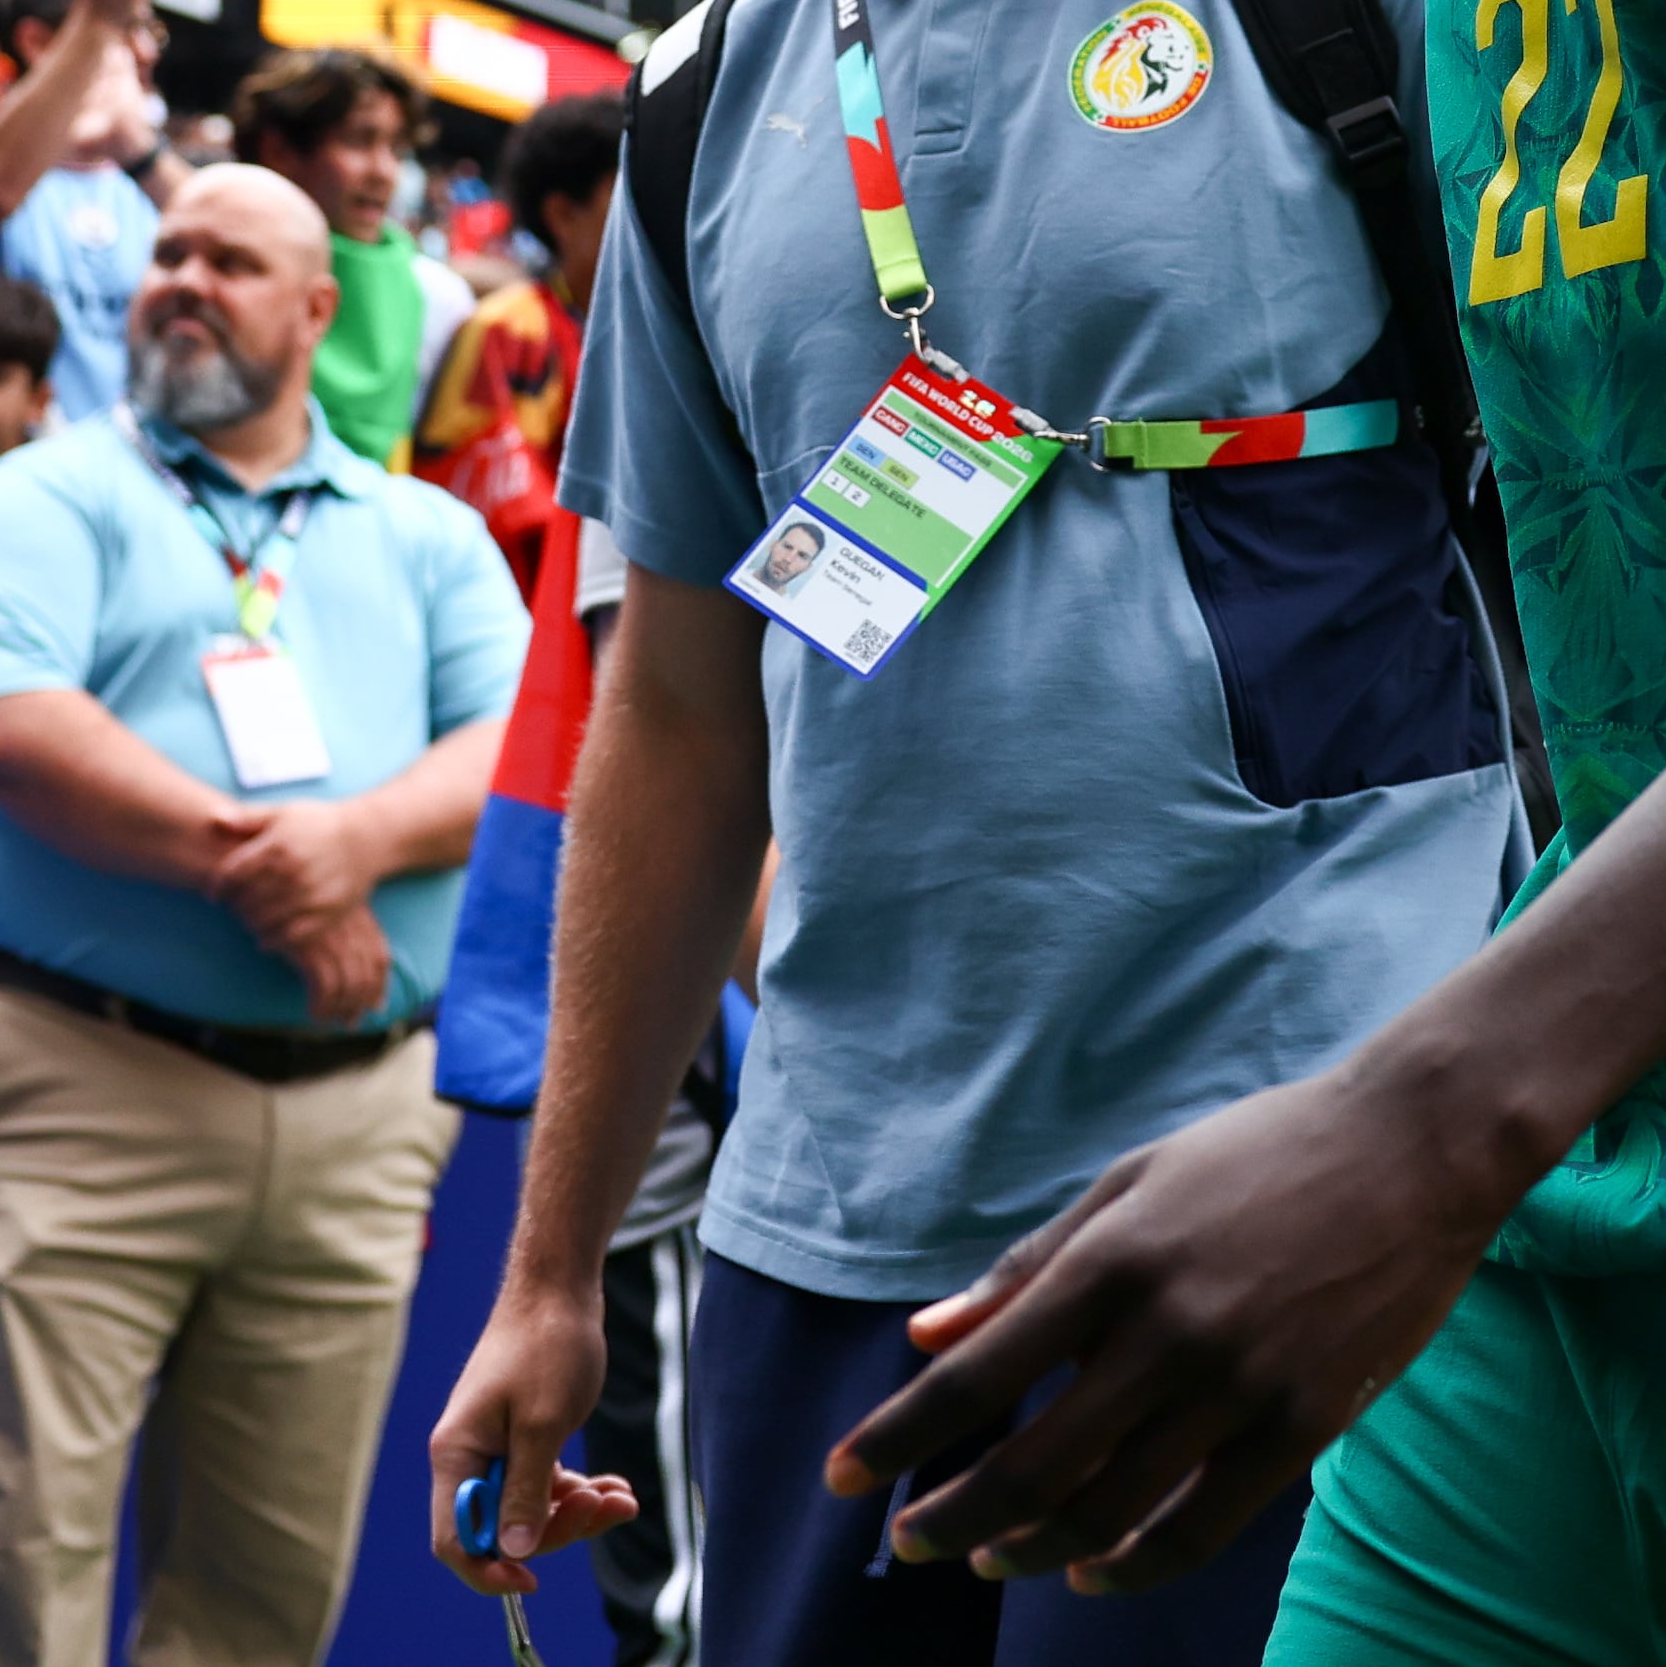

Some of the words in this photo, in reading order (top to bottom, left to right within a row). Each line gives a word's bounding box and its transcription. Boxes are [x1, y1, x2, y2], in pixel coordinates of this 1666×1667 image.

[902, 371, 929, 396] FIFA
[927, 387, 971, 422] WORLD
[967, 415, 995, 436] CUP
[991, 431, 1034, 464] 2026
[840, 454, 872, 481] TEAM
[869, 476, 927, 519] DELEGATE
[831, 559, 862, 584] Kevin
